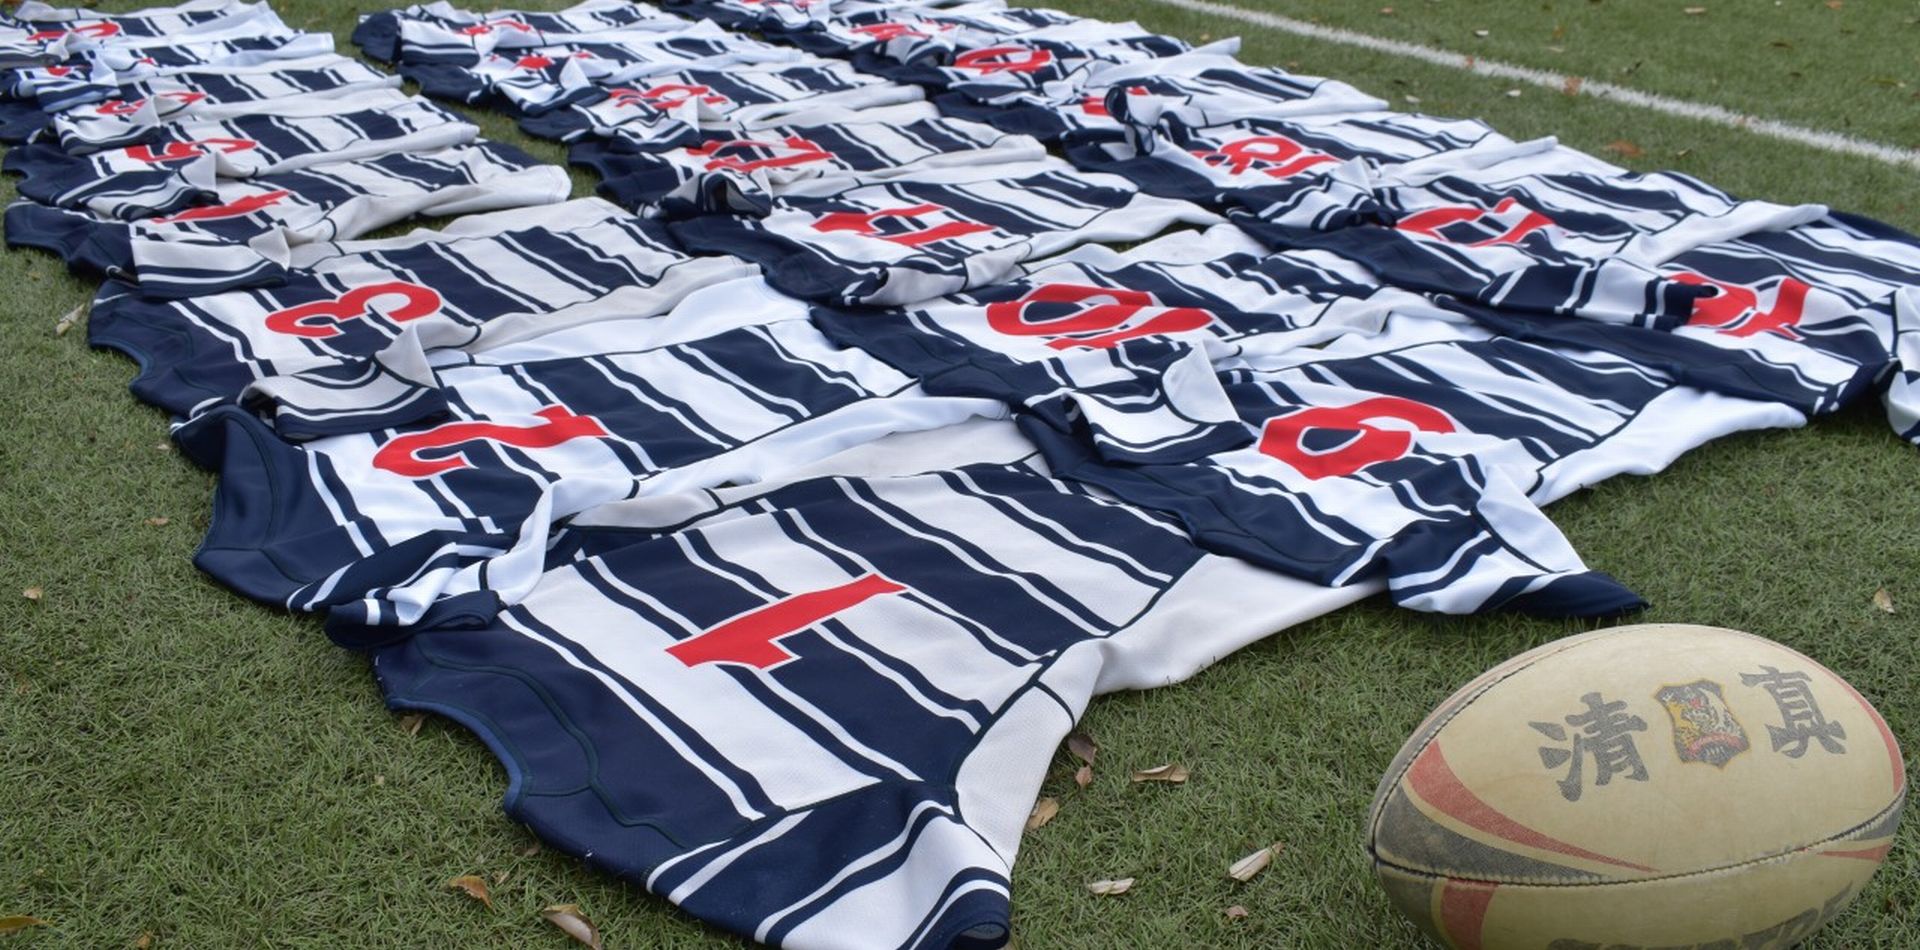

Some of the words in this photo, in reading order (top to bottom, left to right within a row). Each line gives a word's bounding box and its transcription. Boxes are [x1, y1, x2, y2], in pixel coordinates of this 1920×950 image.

[811, 203, 994, 249] 11
[264, 281, 441, 338] 3
[986, 283, 1216, 351] 10
[372, 405, 607, 478] 2
[666, 573, 906, 671] 1
[1528, 691, 1650, 802] 清
[1739, 665, 1847, 759] 真
